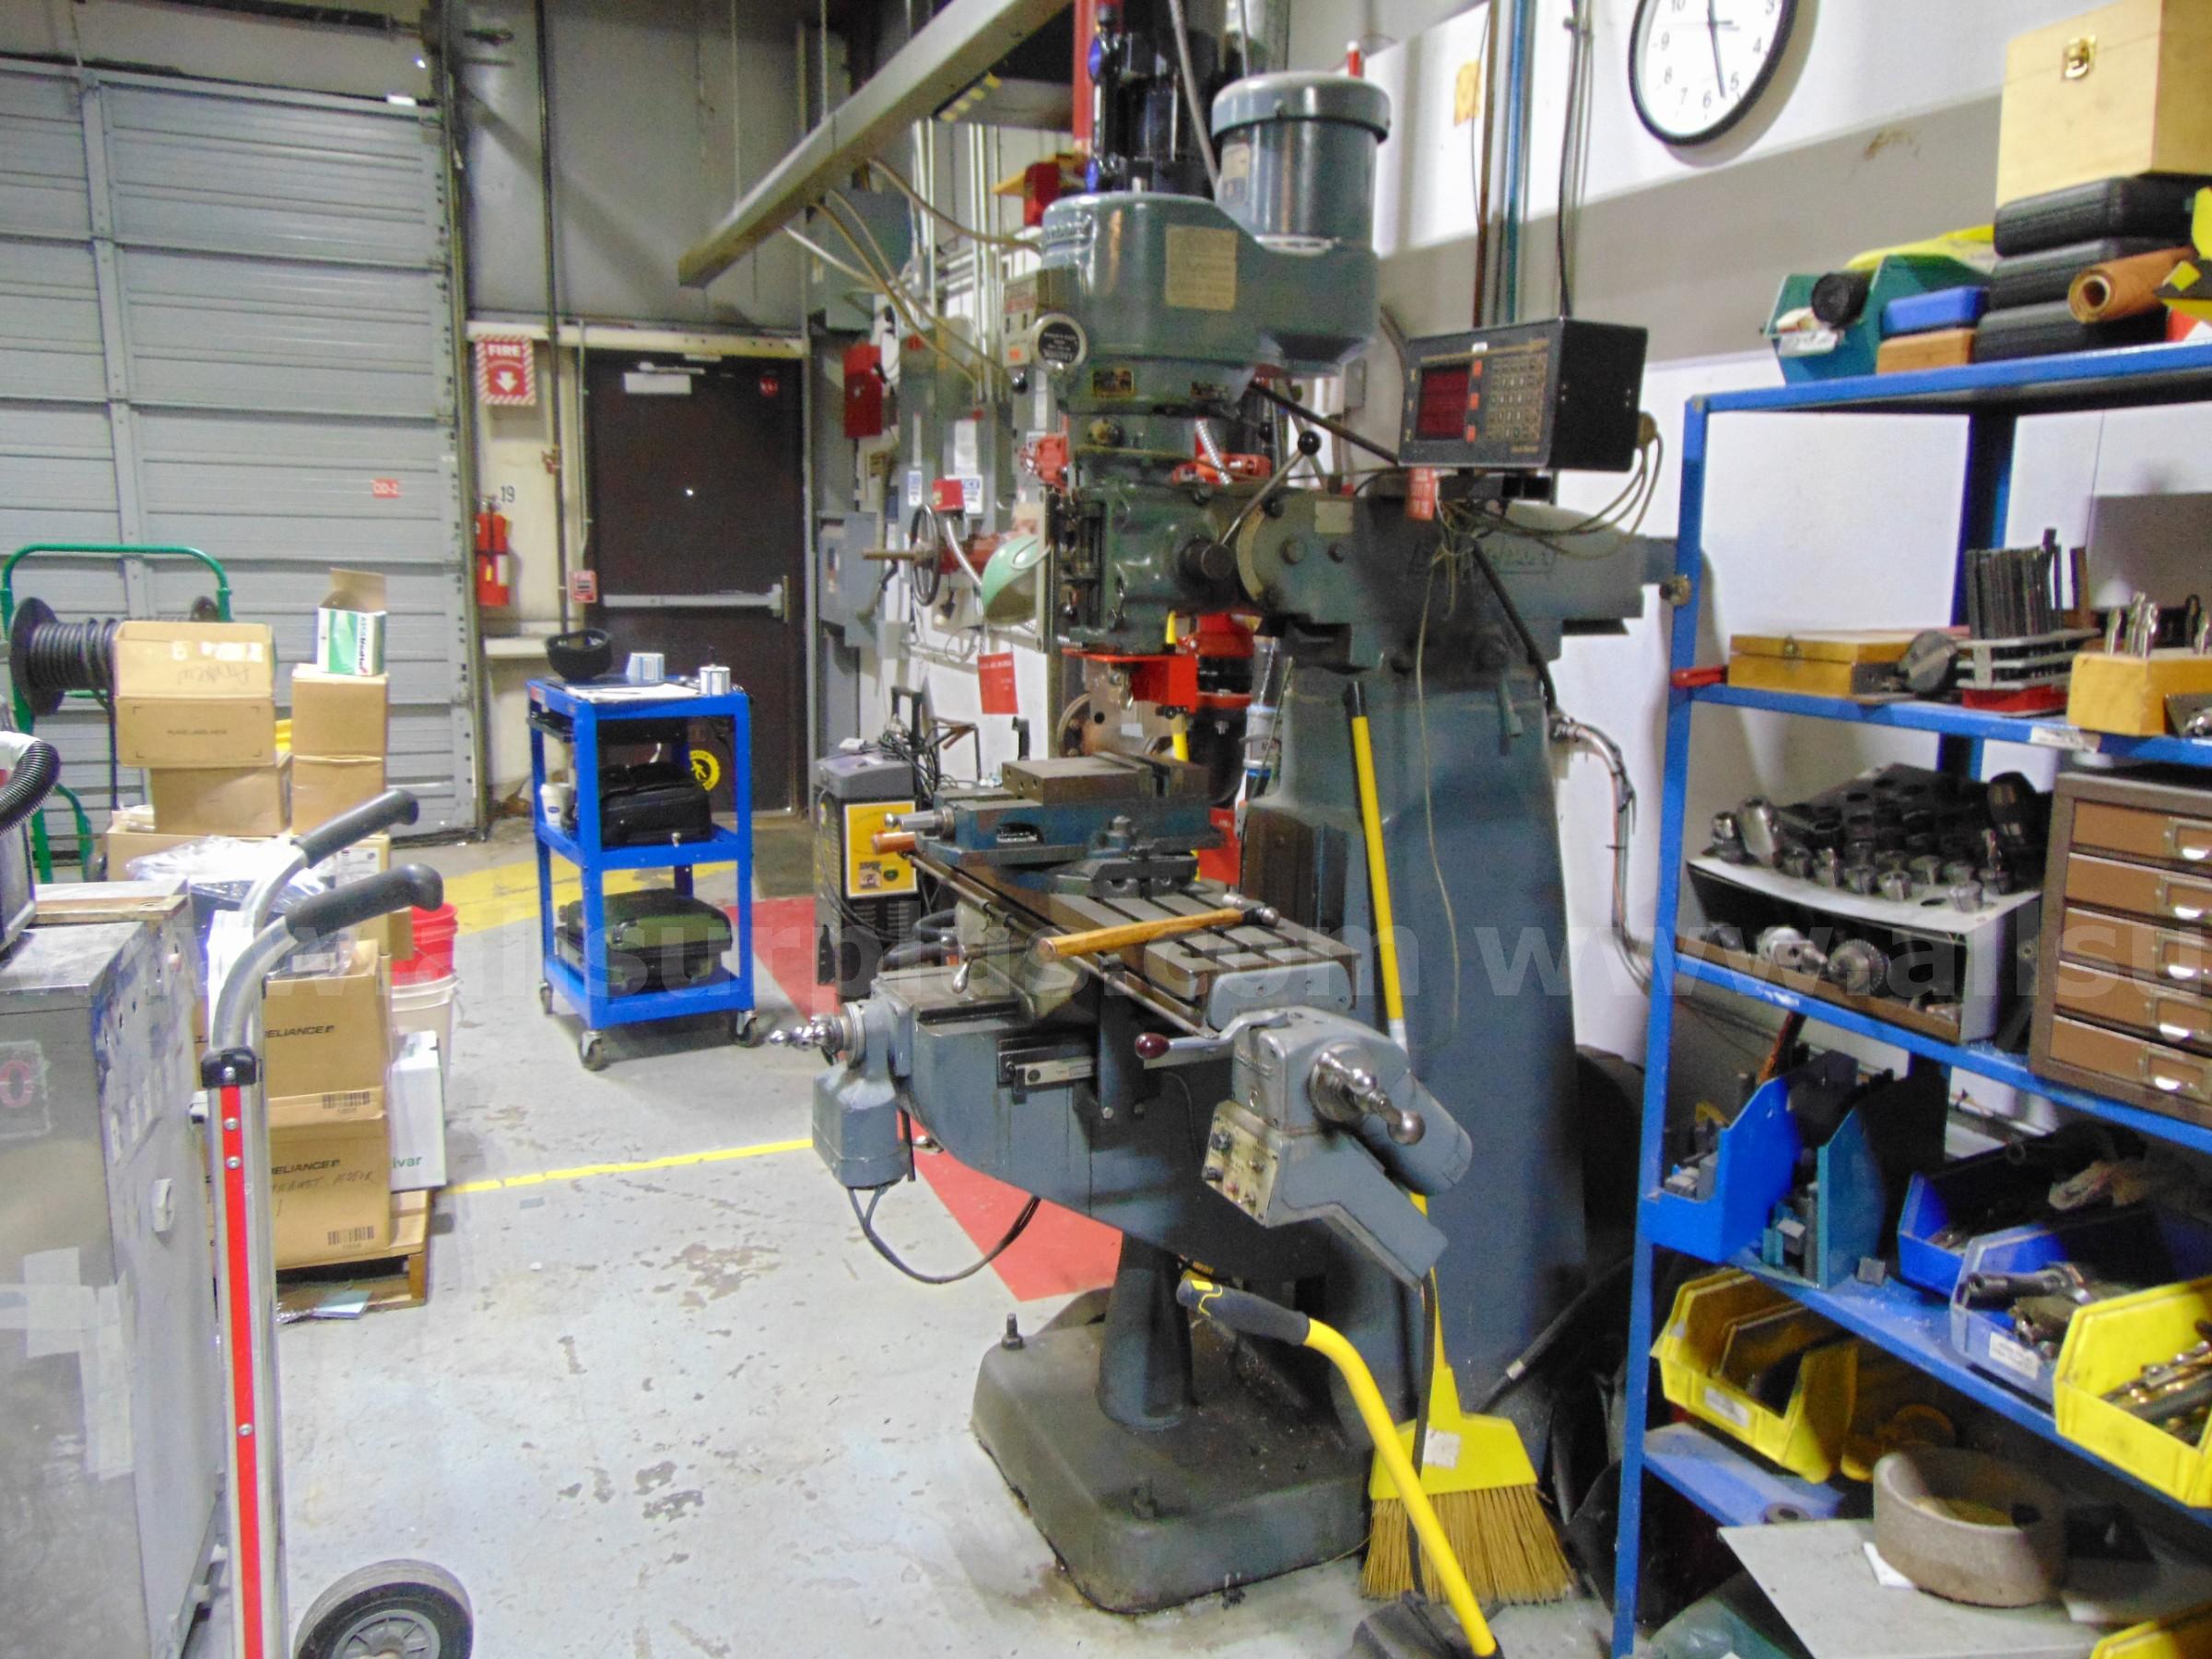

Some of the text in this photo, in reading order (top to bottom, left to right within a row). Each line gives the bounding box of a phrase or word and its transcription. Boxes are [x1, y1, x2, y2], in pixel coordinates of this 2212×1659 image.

[1661, 31, 1671, 51] 9
[1752, 37, 1762, 53] 4
[1664, 66, 1673, 85] 8
[1729, 71, 1740, 91] 5
[1680, 87, 1688, 105] 7
[1702, 89, 1712, 109] 6
[487, 345, 522, 357] FIRE
[500, 486, 516, 503] 19
